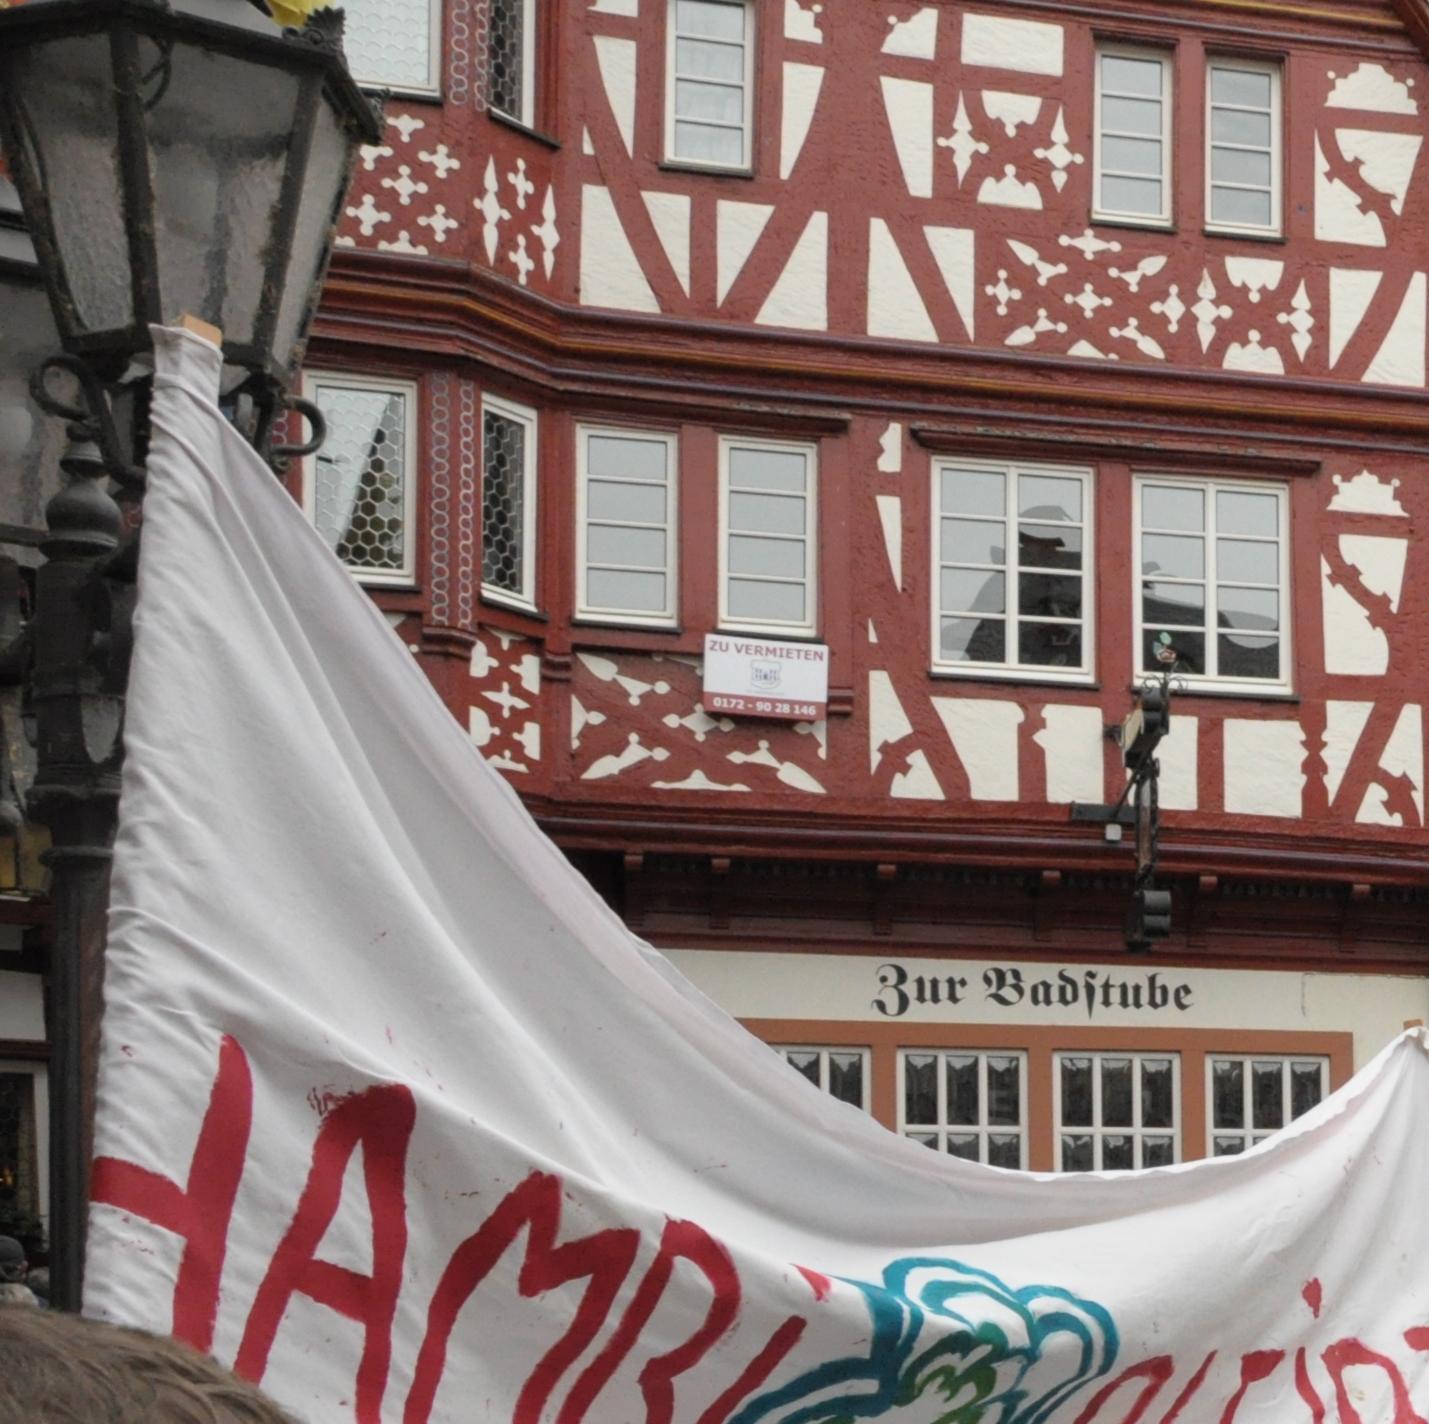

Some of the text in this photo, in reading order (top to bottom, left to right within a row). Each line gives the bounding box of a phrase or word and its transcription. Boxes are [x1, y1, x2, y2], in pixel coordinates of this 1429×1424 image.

[708, 640, 824, 662] ZU VERMIETEN
[713, 697, 745, 710] 0172
[755, 701, 772, 712] 90
[774, 702, 790, 714] 28
[793, 704, 817, 716] 146
[871, 963, 968, 1017] Zur
